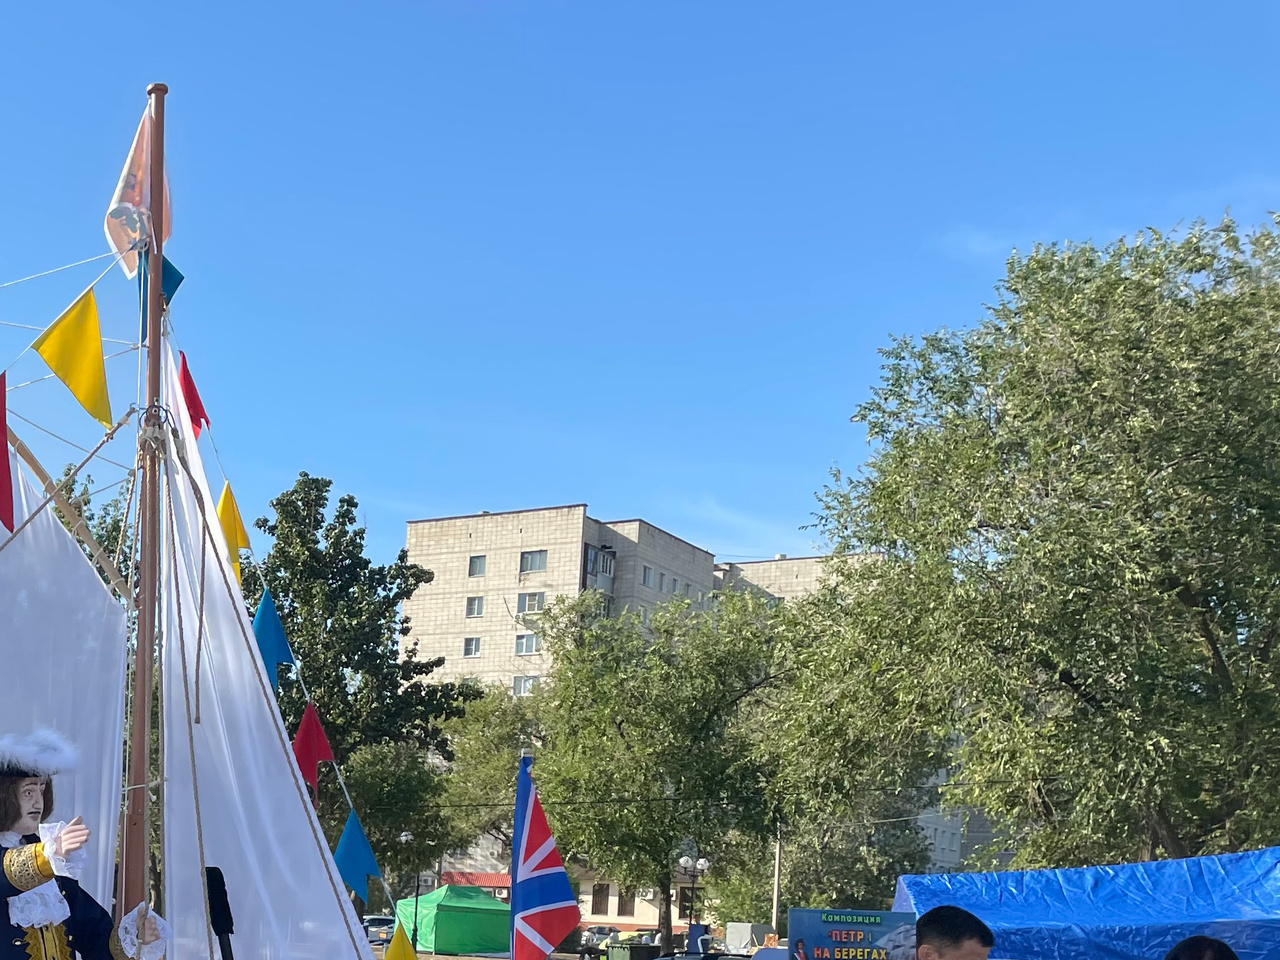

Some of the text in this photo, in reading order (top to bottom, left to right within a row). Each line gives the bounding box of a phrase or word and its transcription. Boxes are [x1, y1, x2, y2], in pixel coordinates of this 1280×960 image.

[821, 912, 881, 924] Композиция
[814, 947, 887, 960] НА БЕРЕГАХ
